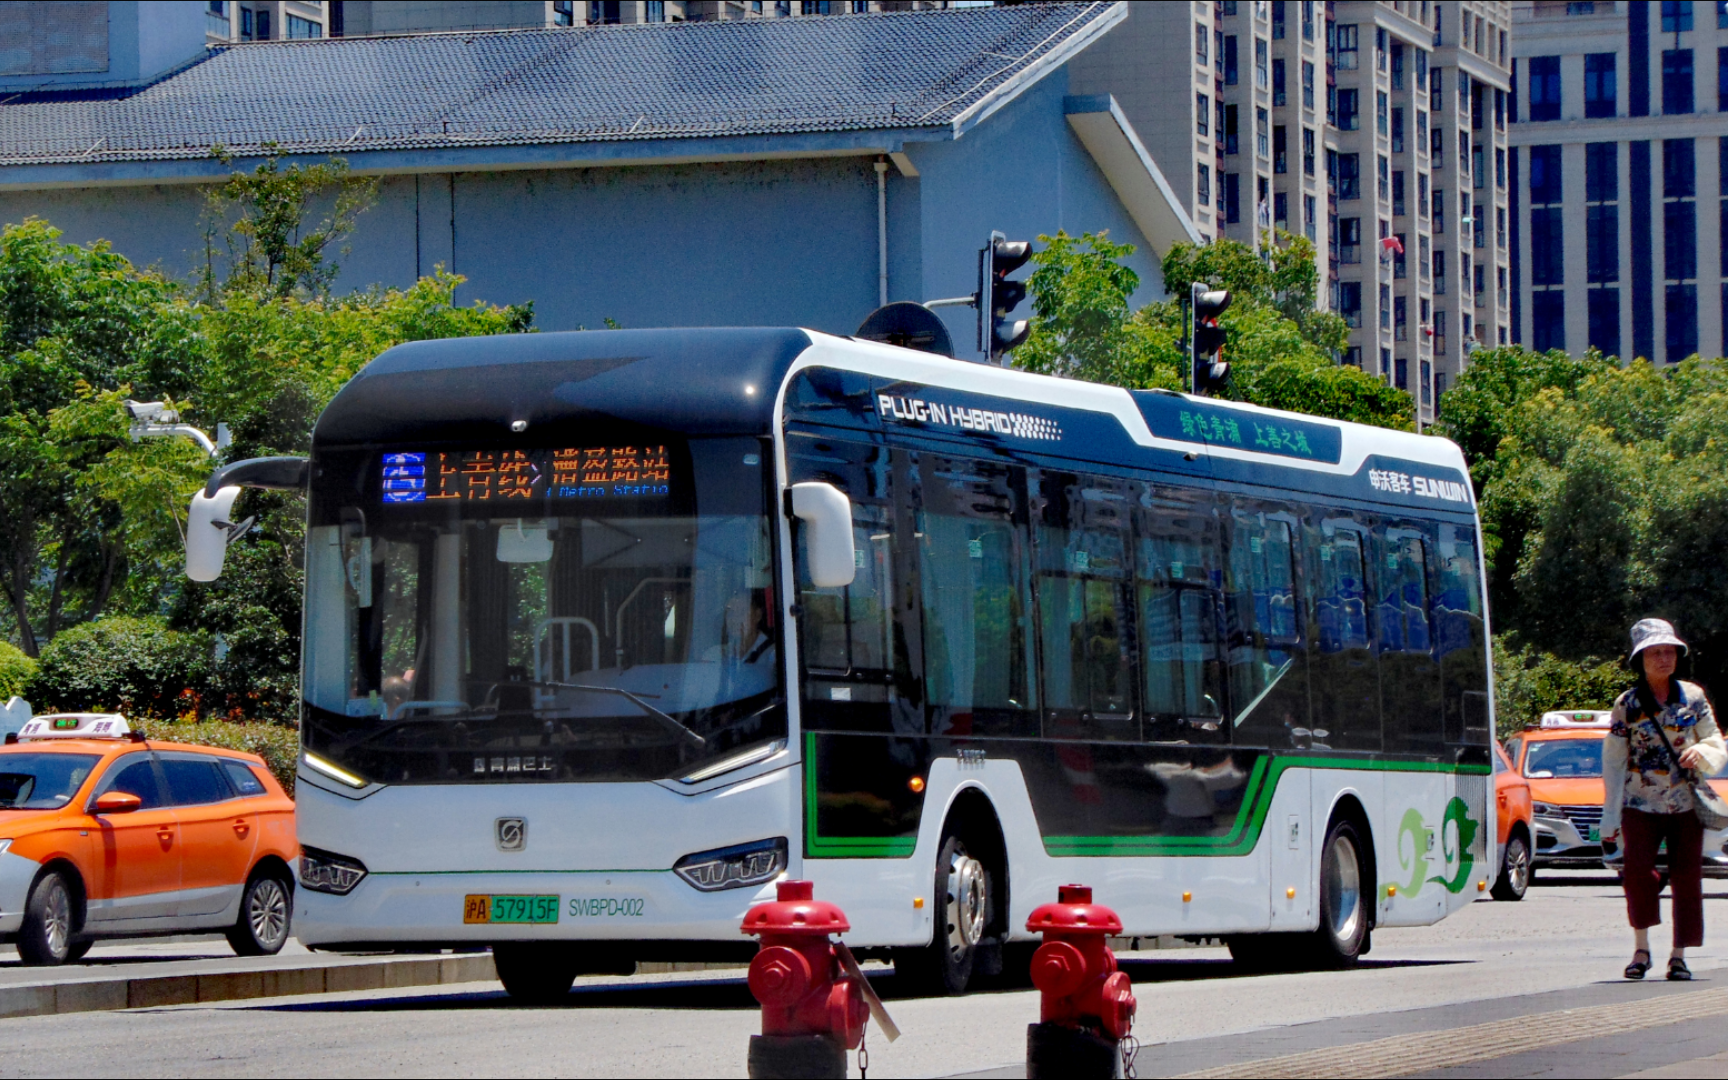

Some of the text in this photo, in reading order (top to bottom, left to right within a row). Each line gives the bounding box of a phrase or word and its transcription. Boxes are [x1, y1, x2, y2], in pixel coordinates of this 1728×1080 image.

[878, 394, 1012, 434] PLUG-IN HYBRID
[1368, 468, 1469, 503] 申沃客车 SUNWIN
[494, 898, 558, 920] 57915F
[568, 898, 645, 917] SWBPD-002
